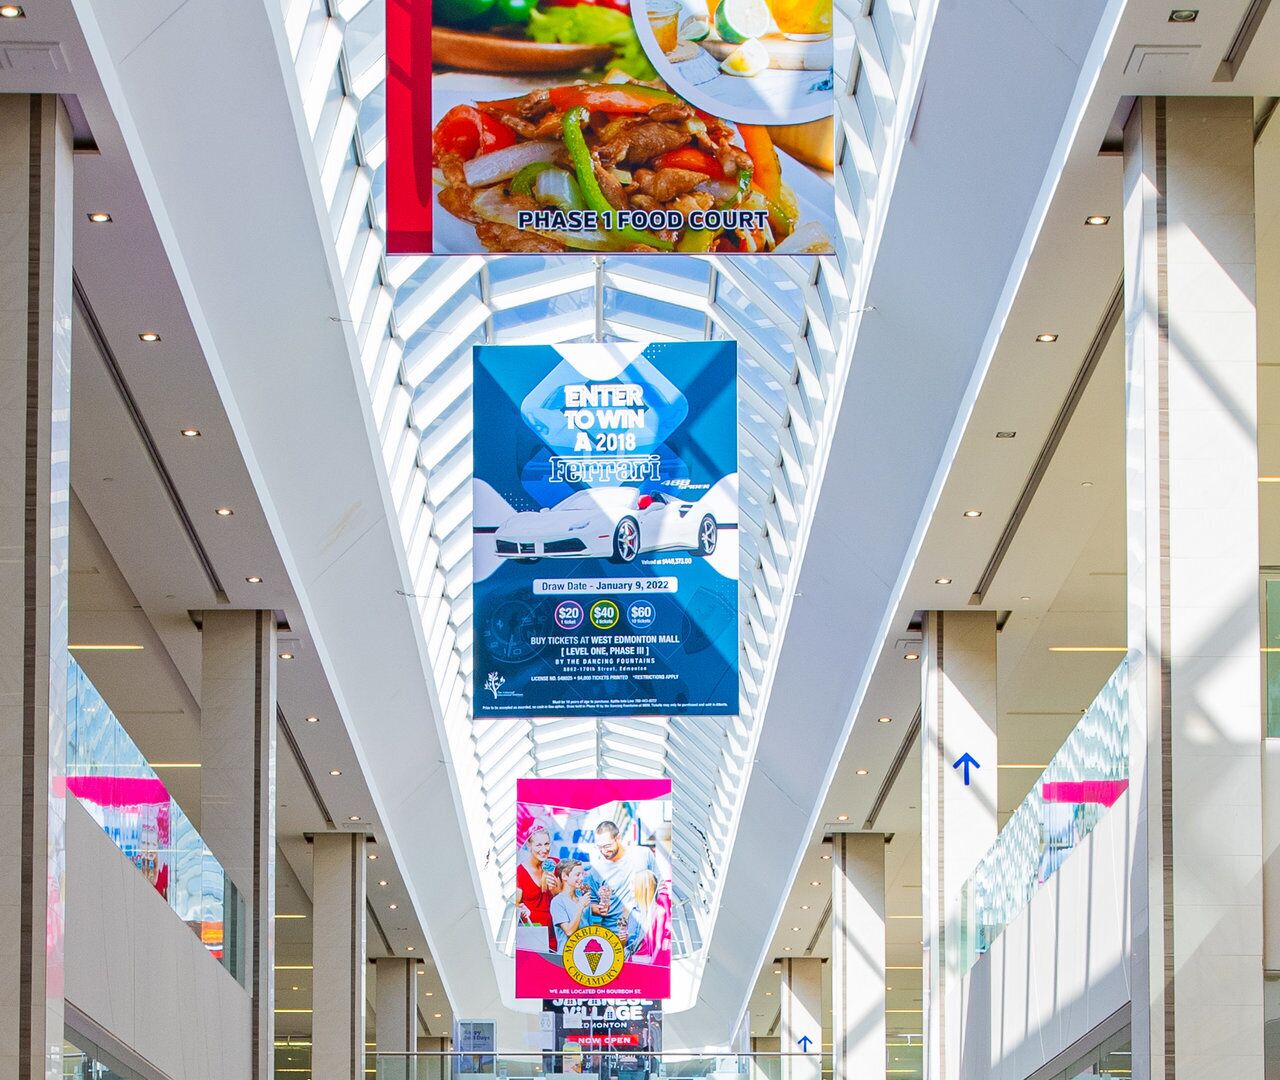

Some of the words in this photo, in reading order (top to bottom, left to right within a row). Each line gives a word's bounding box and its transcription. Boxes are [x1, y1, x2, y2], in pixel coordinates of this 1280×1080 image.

[518, 210, 597, 230] PHASE
[602, 211, 612, 229] 1
[617, 210, 684, 229] FOOD
[689, 210, 768, 230] COURT
[564, 384, 644, 407] ENTER
[564, 409, 595, 430] TO
[596, 409, 645, 430] WIN
[574, 432, 592, 452] A
[596, 432, 636, 452] 2018
[549, 455, 661, 482] Ferrari
[542, 582, 565, 591] Draw
[567, 582, 587, 591] Date
[596, 581, 633, 592] January
[635, 581, 644, 591] 9,
[646, 580, 669, 590] 2022
[558, 607, 579, 619] $20
[594, 606, 615, 618] $40
[631, 606, 651, 618] $60
[530, 637, 546, 645] BUY
[548, 636, 578, 645] TICKETS
[580, 636, 590, 645] AT
[591, 636, 612, 645] WEST
[614, 635, 657, 644] EDMONTON
[658, 635, 680, 644] MALL
[566, 648, 589, 656] LEVEL
[590, 647, 608, 656] ONE,
[610, 647, 634, 655] PHASE
[637, 647, 645, 655] III
[565, 925, 600, 953] MARBLE
[604, 928, 623, 955] SLAB
[568, 965, 618, 986] CREAMERY
